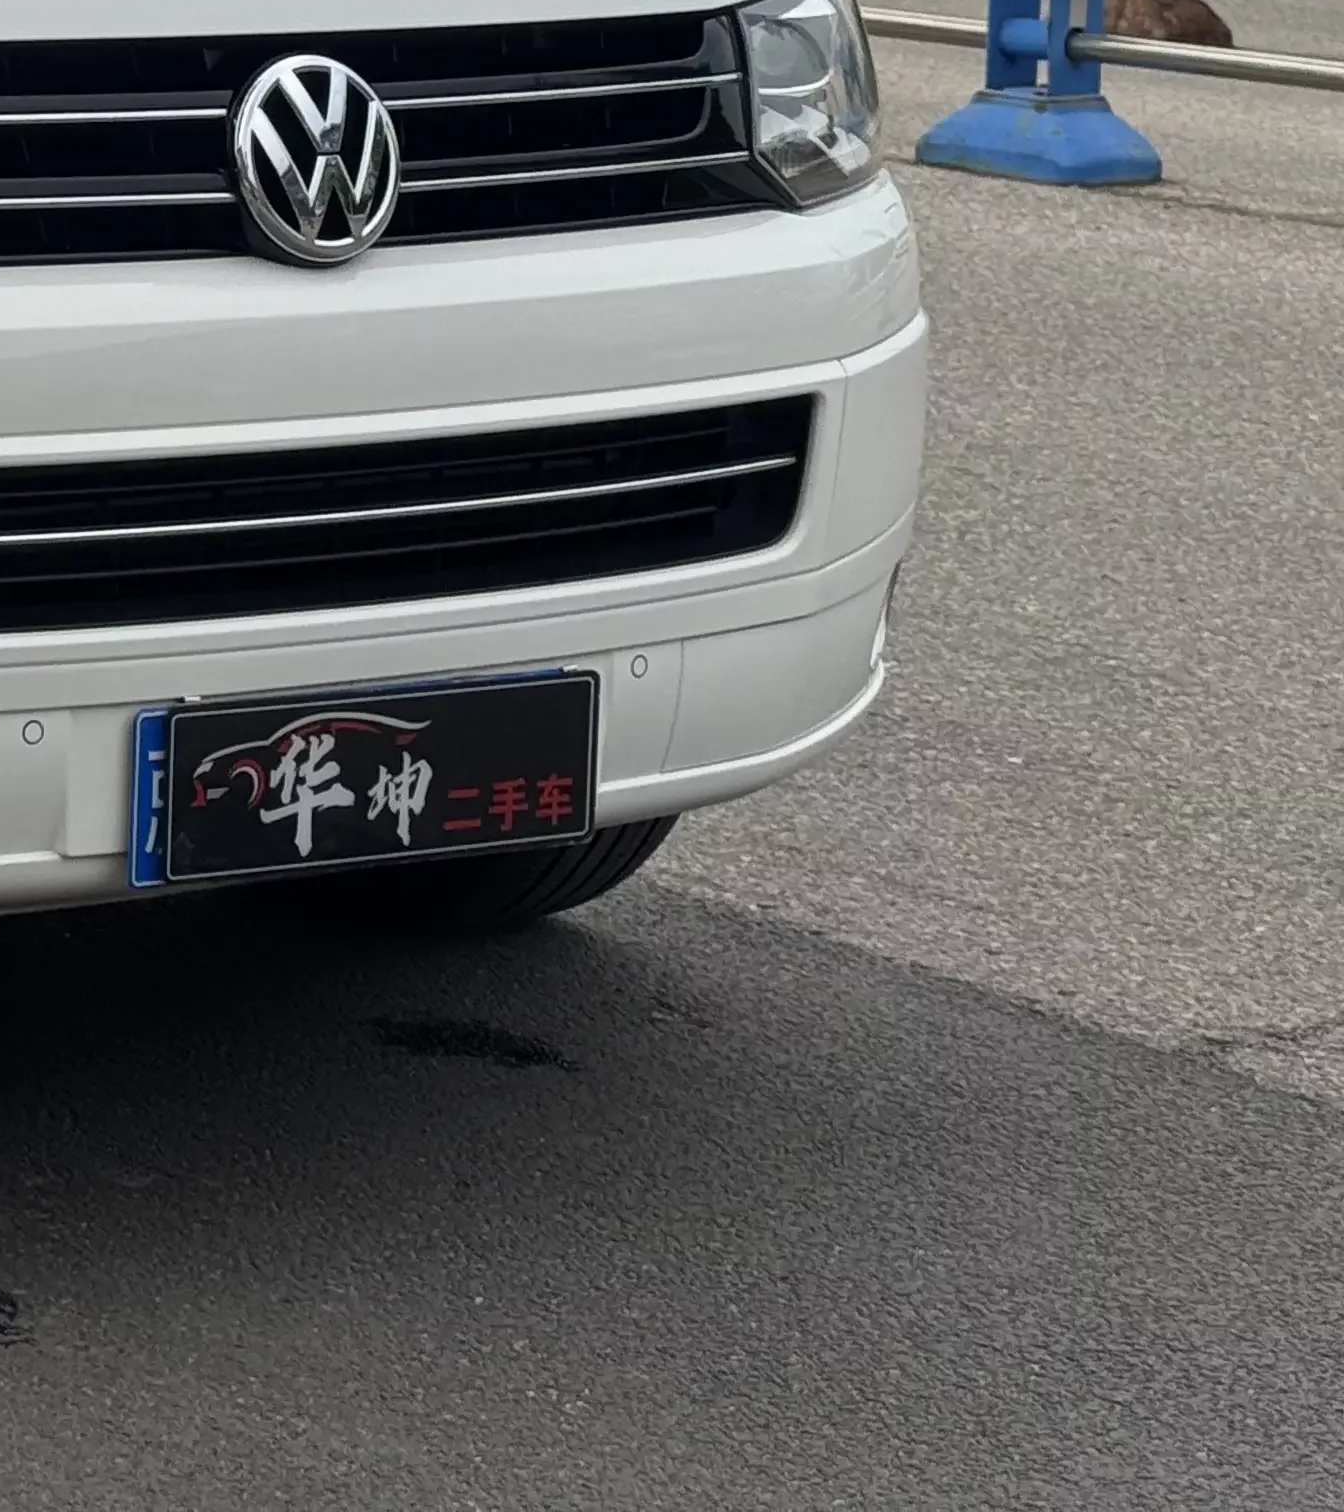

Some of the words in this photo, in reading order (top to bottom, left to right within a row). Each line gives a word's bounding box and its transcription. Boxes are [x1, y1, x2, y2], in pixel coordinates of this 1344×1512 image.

[260, 733, 434, 858] 华坤
[443, 774, 574, 832] 二手车
